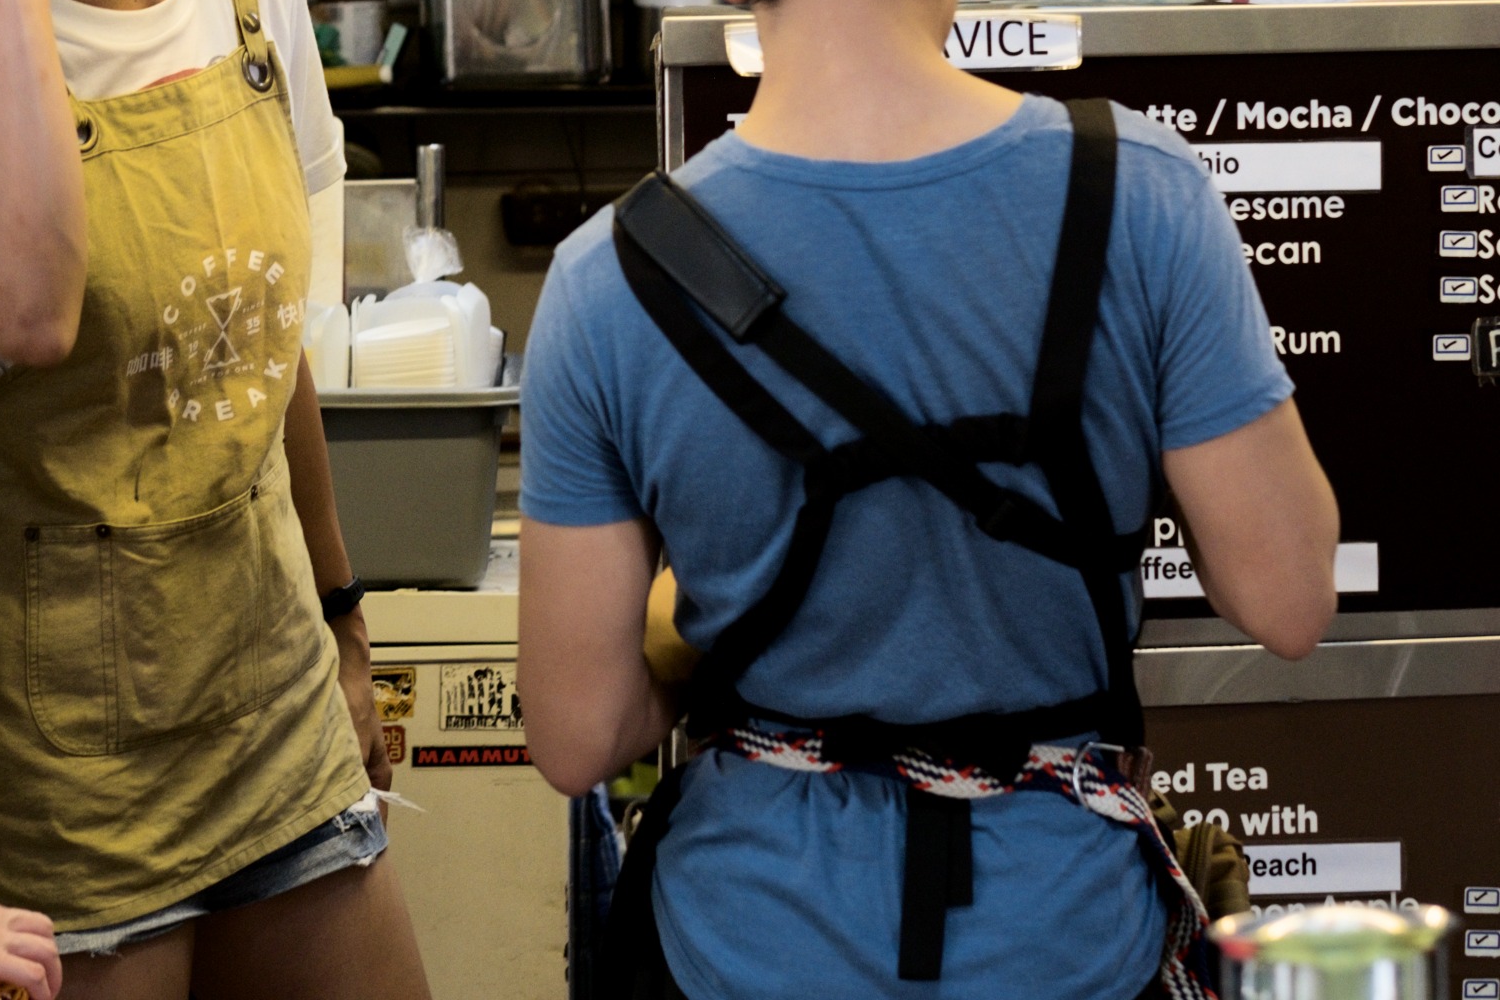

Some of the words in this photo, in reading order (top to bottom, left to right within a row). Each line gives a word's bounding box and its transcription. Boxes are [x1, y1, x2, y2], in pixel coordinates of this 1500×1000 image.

[943, 20, 1049, 58] VICE
[1133, 103, 1197, 132] tte
[1236, 99, 1353, 131] Mocha
[1478, 136, 1500, 158] C
[1220, 193, 1346, 221] esame
[1479, 185, 1500, 214] R
[1477, 229, 1500, 260] S
[163, 248, 285, 325] COFFEE
[1479, 273, 1500, 304] S
[1270, 326, 1341, 354] Rum
[167, 358, 289, 422] BREAK
[1206, 762, 1268, 792] Tea
[1240, 803, 1318, 836] with
[1243, 852, 1317, 877] each
